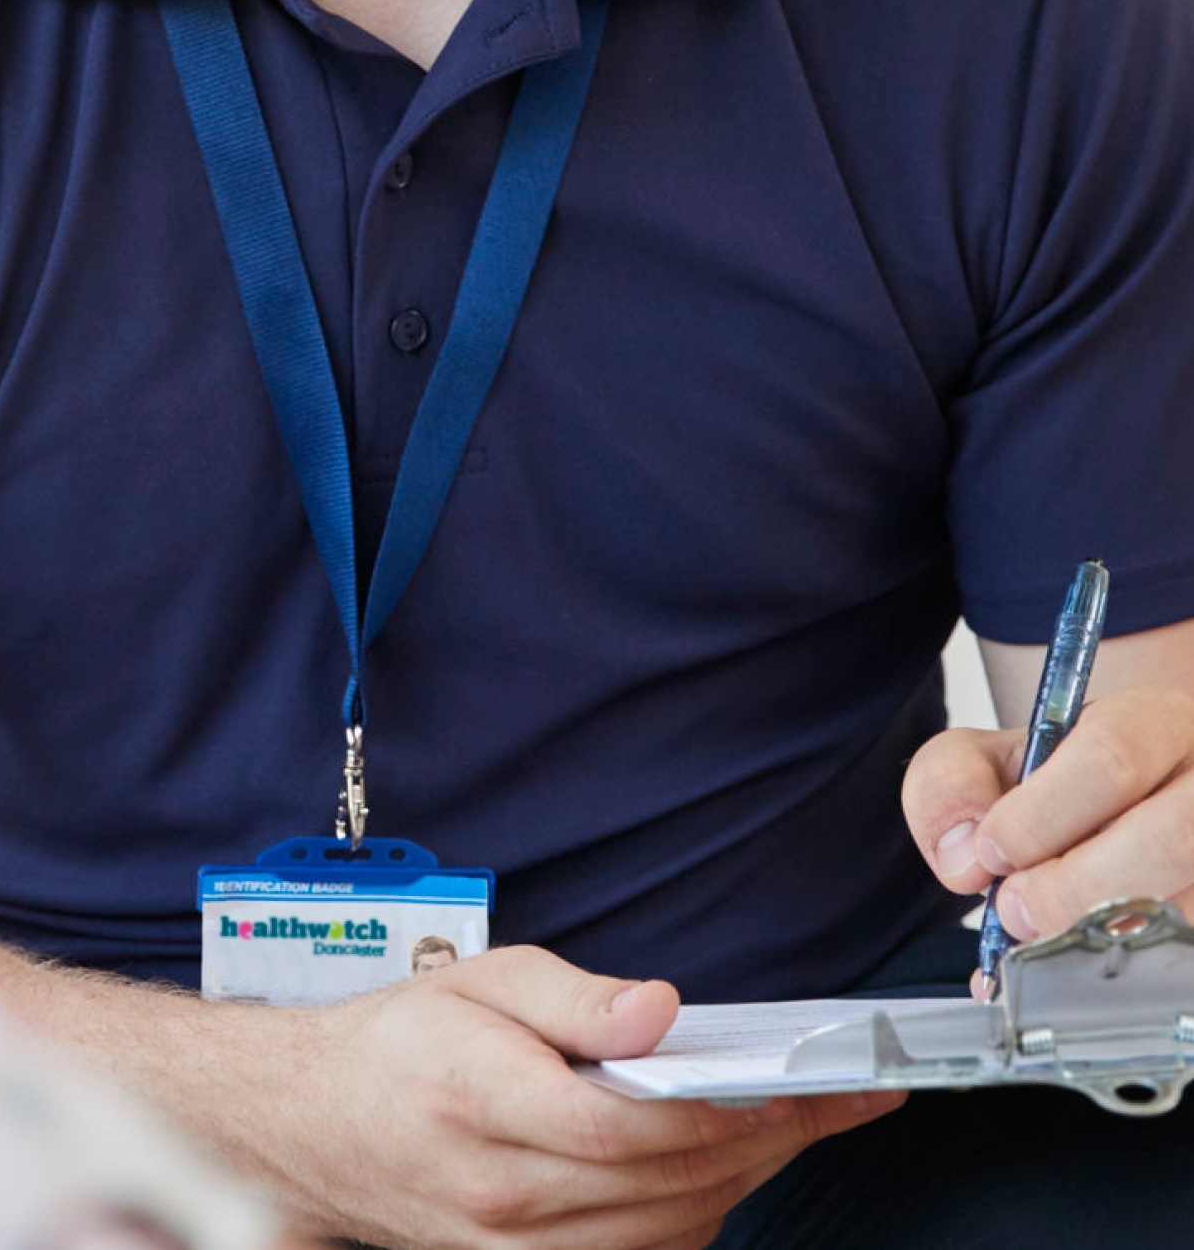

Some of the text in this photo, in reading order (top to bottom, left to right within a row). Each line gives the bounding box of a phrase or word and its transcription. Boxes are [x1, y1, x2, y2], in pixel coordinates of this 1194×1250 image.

[214, 881, 353, 893] IDENTIFICATION BADGE
[220, 916, 387, 940] healthwatch
[313, 942, 386, 956] Doncaster
